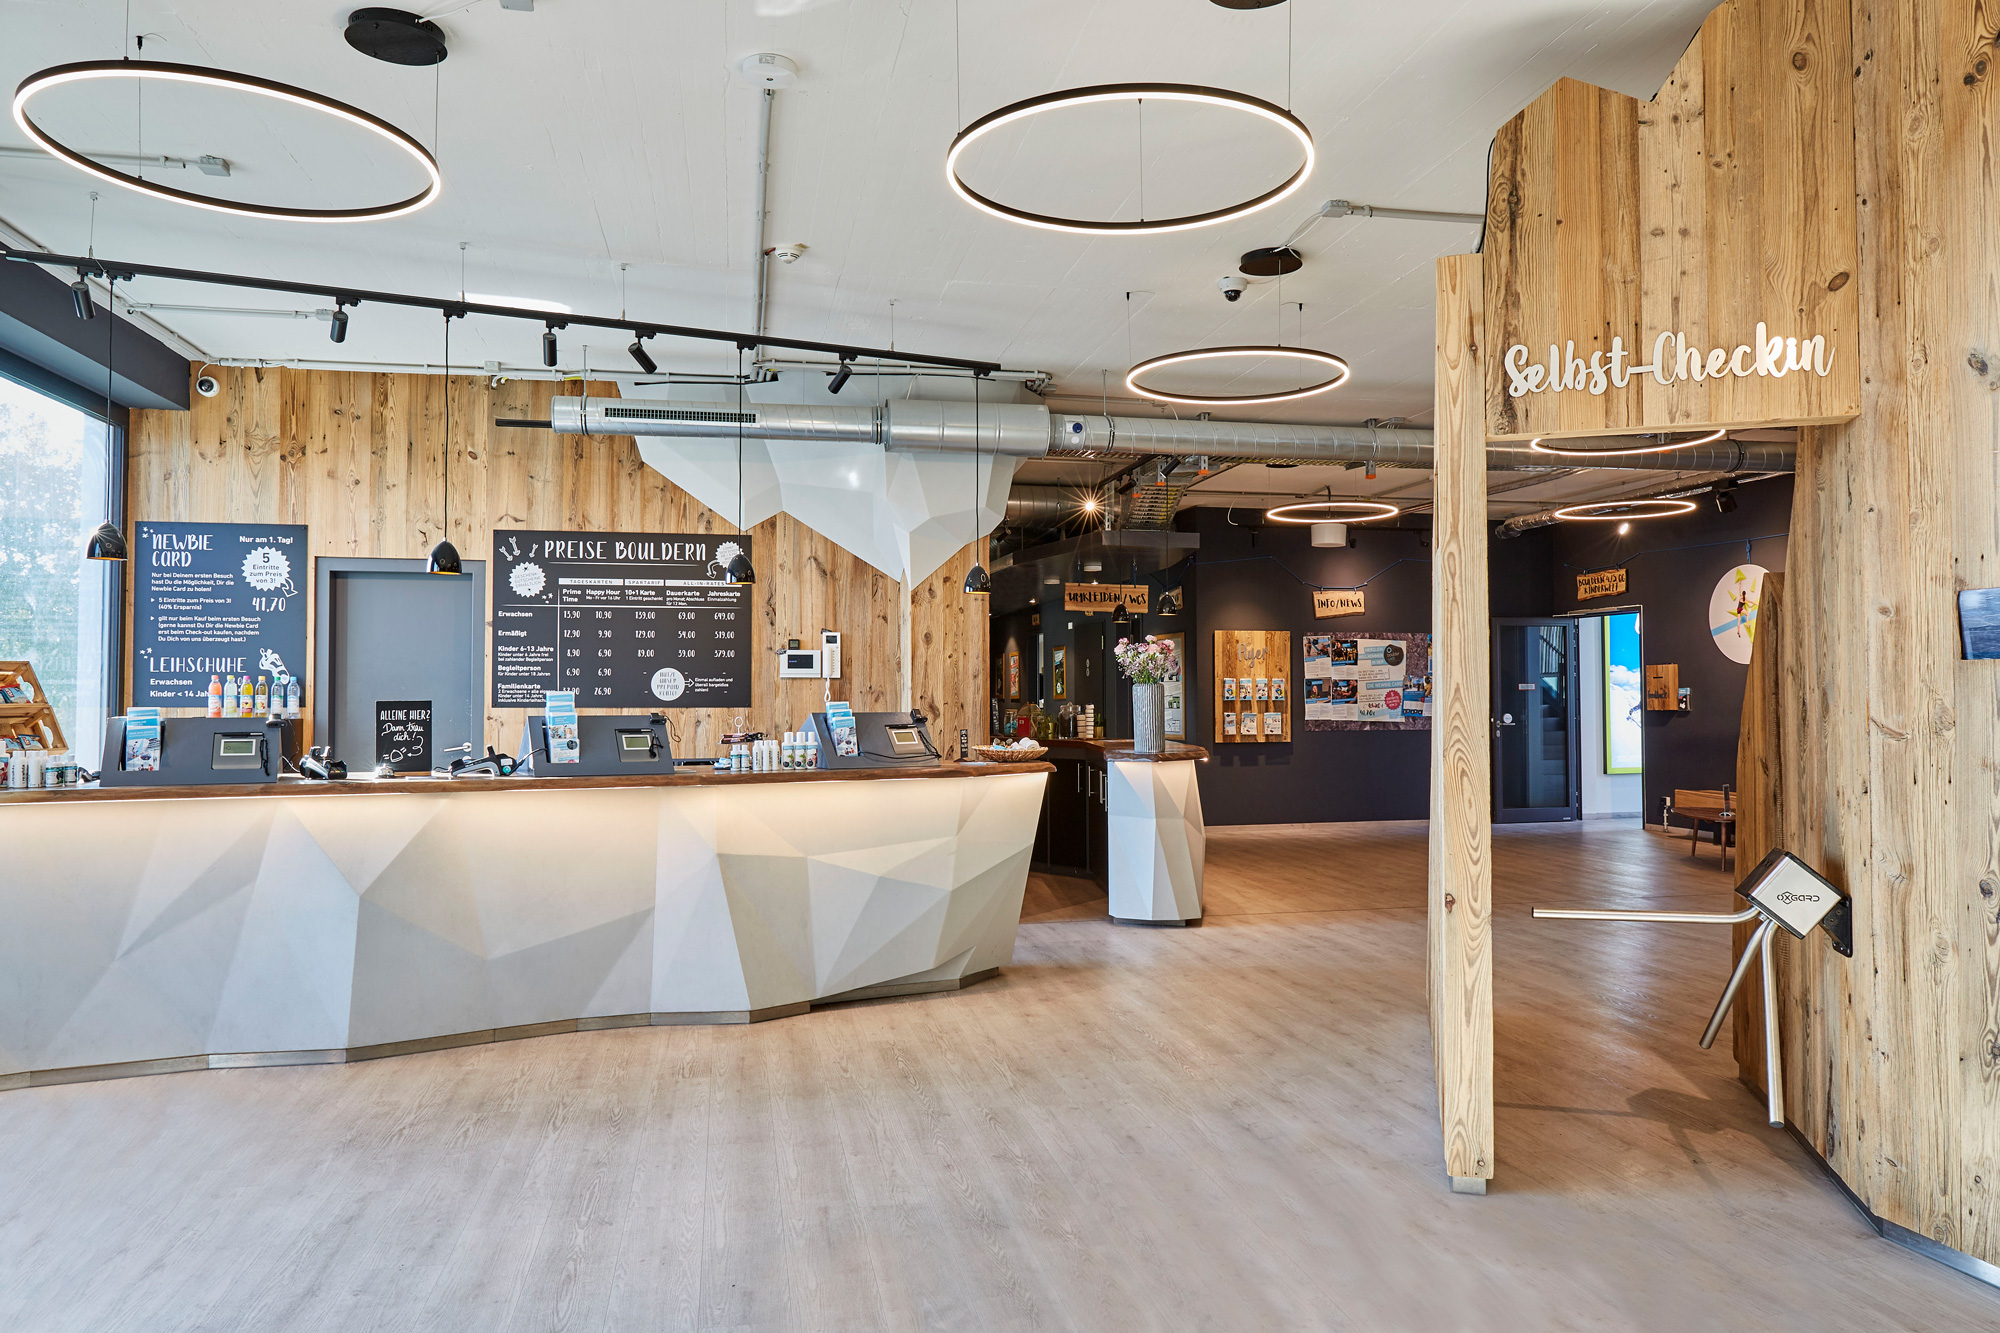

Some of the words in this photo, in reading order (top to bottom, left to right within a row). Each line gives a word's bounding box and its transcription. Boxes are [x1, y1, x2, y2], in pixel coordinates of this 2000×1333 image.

[152, 534, 213, 550] NEWBIE
[277, 536, 293, 544] Tag!
[545, 540, 607, 559] PREISE
[615, 541, 705, 561] BOULDERN
[152, 551, 191, 567] CARD
[262, 552, 270, 563] 5
[252, 597, 285, 612] 41,70
[598, 630, 612, 638] 9.90
[150, 657, 246, 672] LEIHSCHUHE
[380, 709, 408, 721] ALLEINE
[409, 709, 431, 722] HIER?
[1777, 891, 1820, 905] OXGARD
